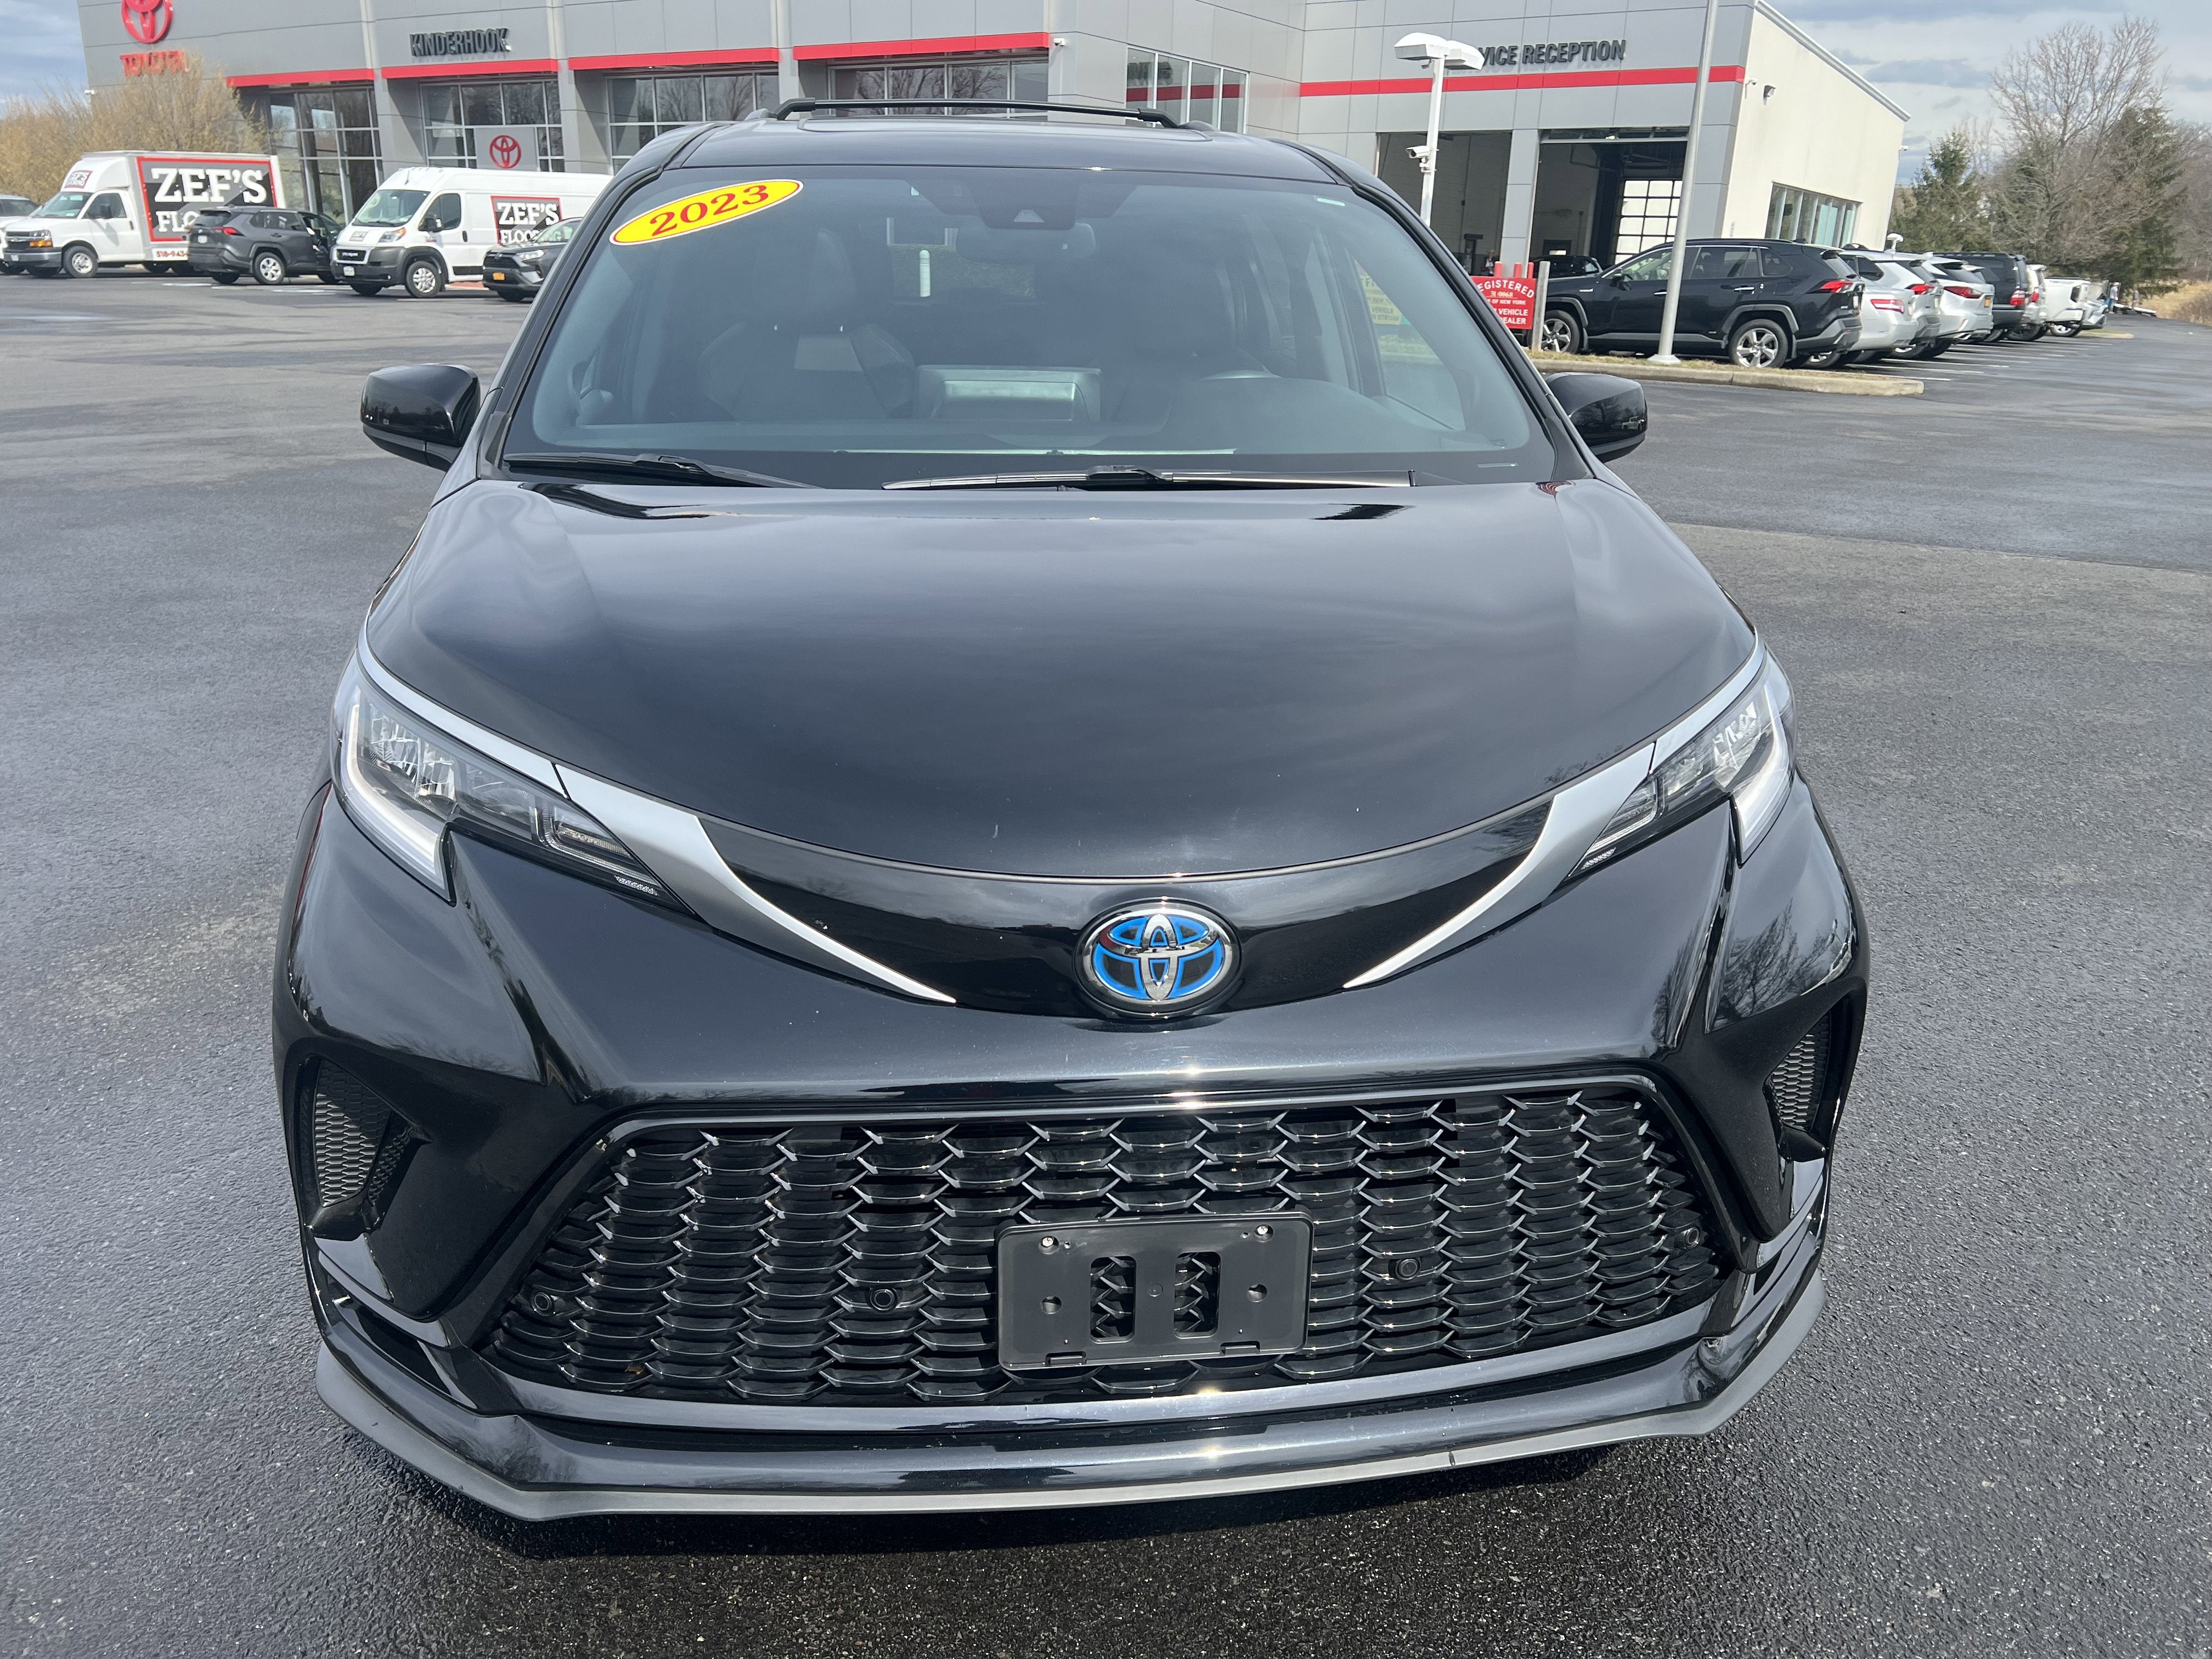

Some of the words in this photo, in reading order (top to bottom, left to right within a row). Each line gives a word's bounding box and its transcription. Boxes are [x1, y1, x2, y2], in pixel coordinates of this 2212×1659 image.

[410, 28, 511, 56] KINDERHOOK
[1478, 46, 1518, 66] VICE
[1522, 40, 1626, 64] RECEPTION
[151, 168, 267, 204] ZEF'S
[497, 202, 560, 225] ZEF'S
[650, 185, 769, 236] 2023
[1477, 280, 1534, 298] EGISTERED
